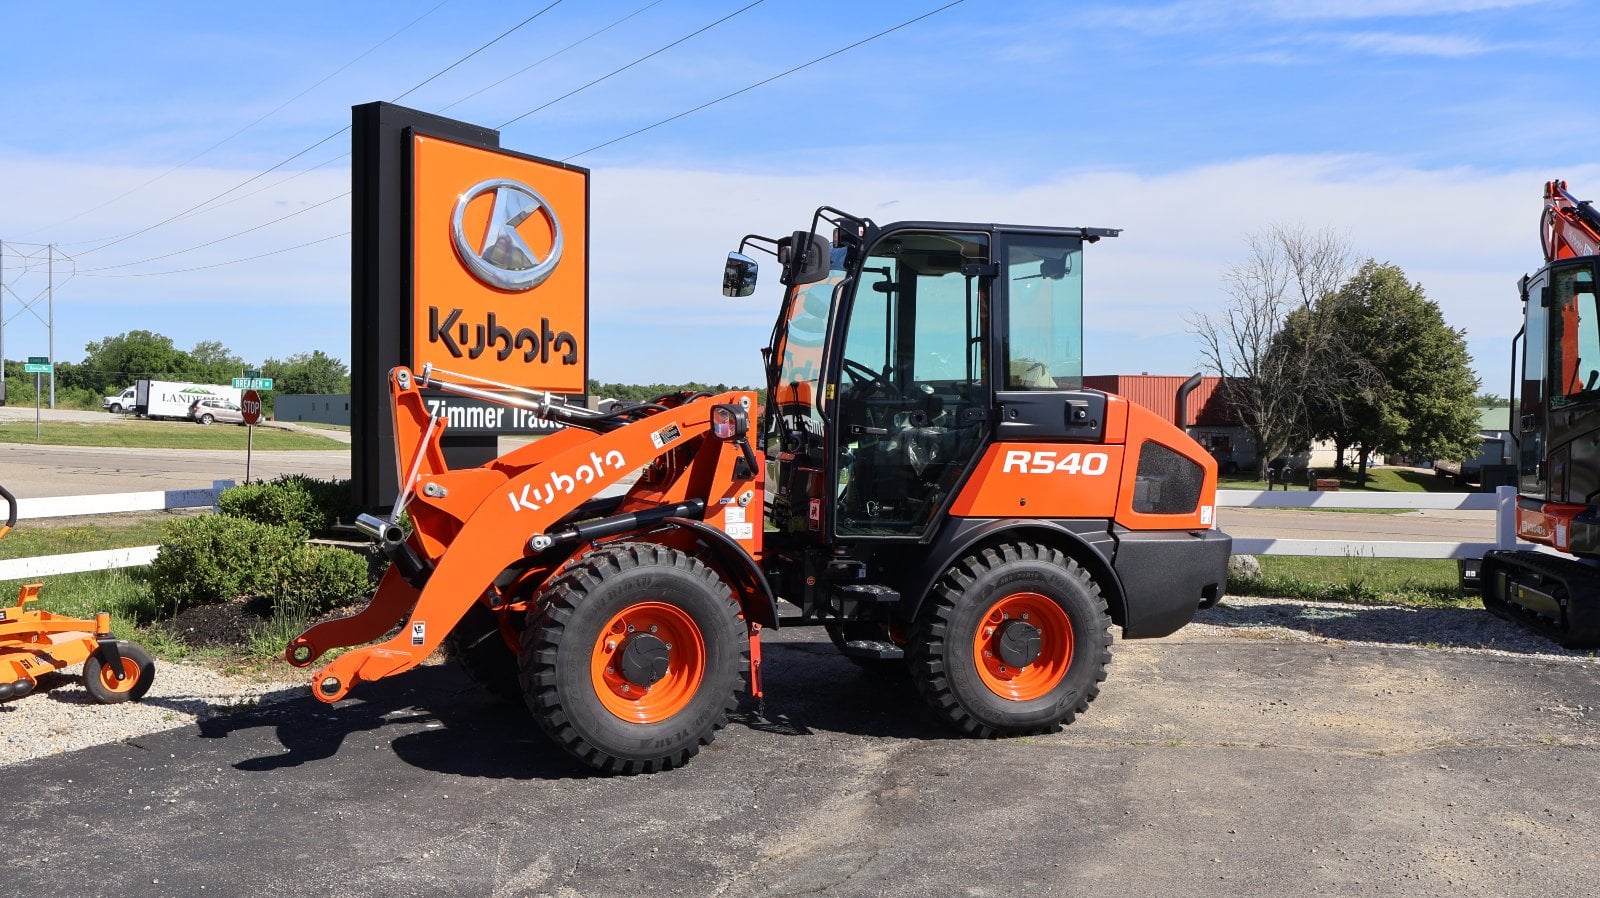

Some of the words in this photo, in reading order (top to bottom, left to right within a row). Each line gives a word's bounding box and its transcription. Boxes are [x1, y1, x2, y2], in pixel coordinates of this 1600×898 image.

[429, 306, 577, 365] Kubota
[242, 401, 260, 415] STOP
[428, 399, 504, 428] Zimmer
[513, 407, 572, 429] Trac
[1003, 450, 1109, 476] R540
[508, 450, 626, 512] Kubota
